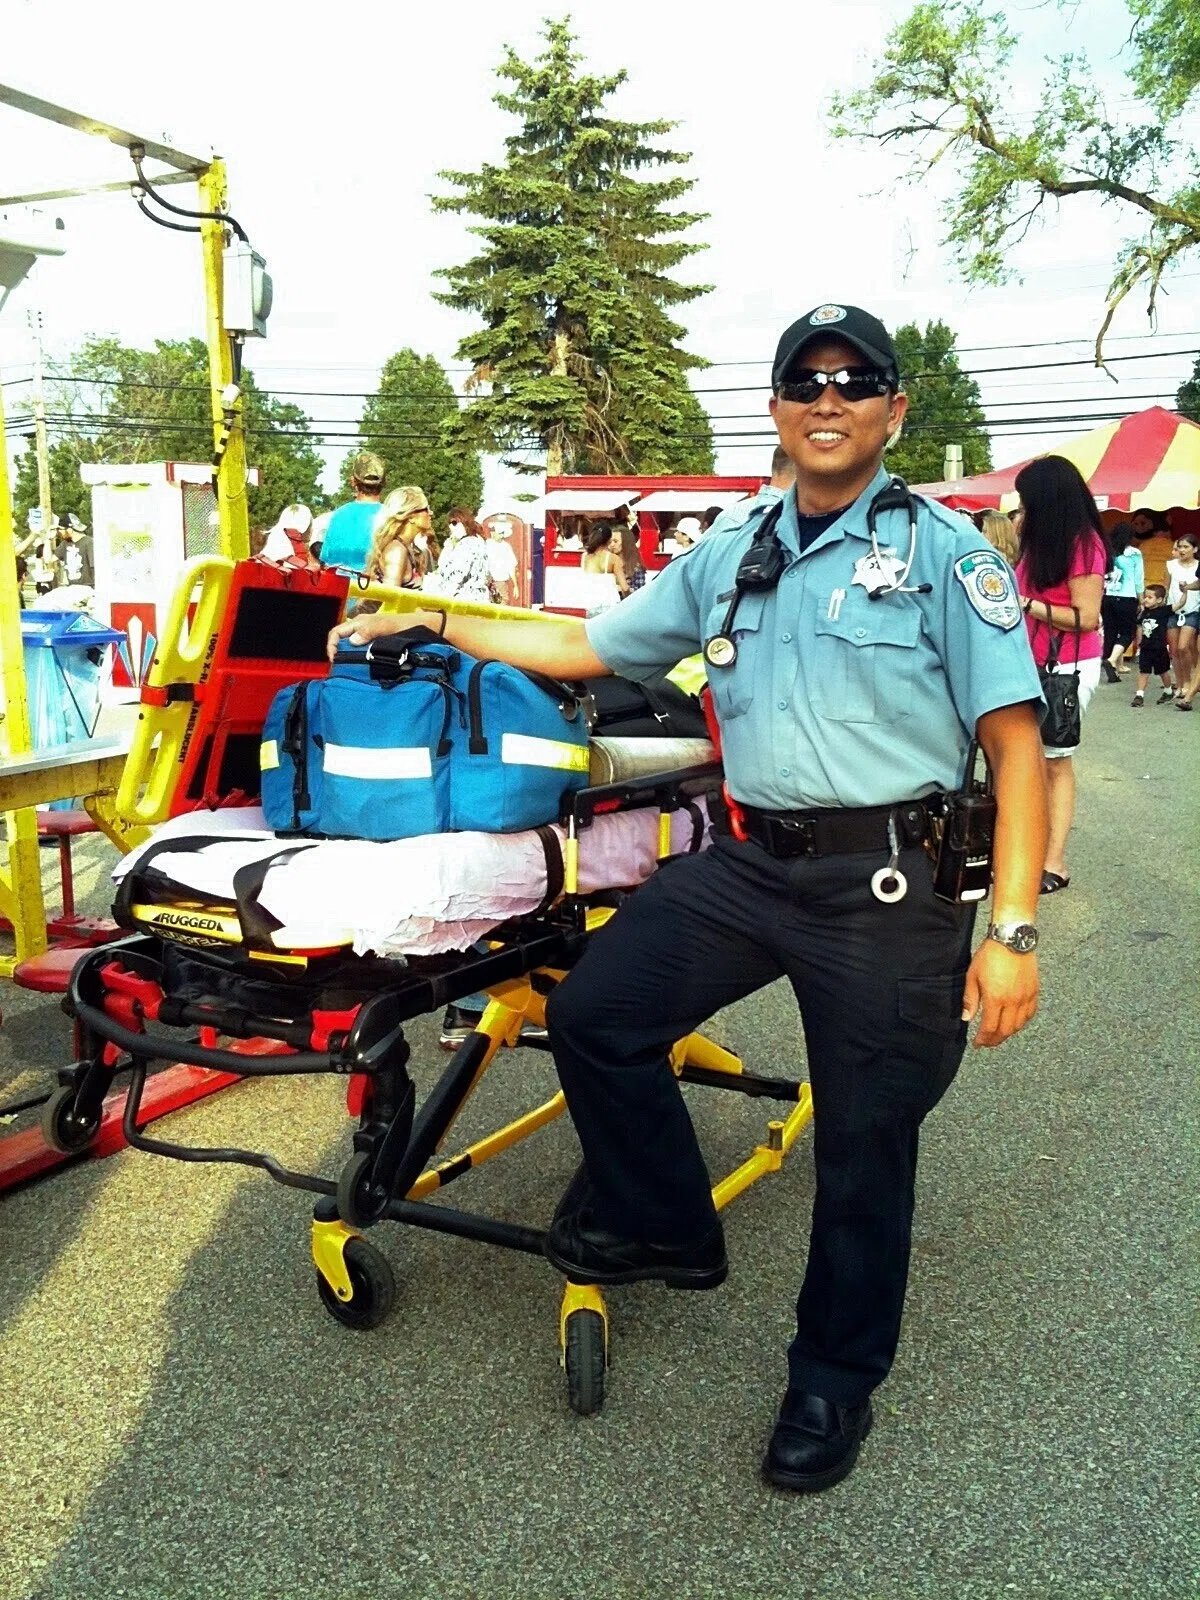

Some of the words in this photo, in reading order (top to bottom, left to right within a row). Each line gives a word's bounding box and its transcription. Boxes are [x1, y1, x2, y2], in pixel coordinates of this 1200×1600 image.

[205, 633, 218, 659] 100%
[199, 663, 210, 684] X-R
[178, 701, 201, 763] RANSLUCENT
[160, 912, 217, 930] RUGGED
